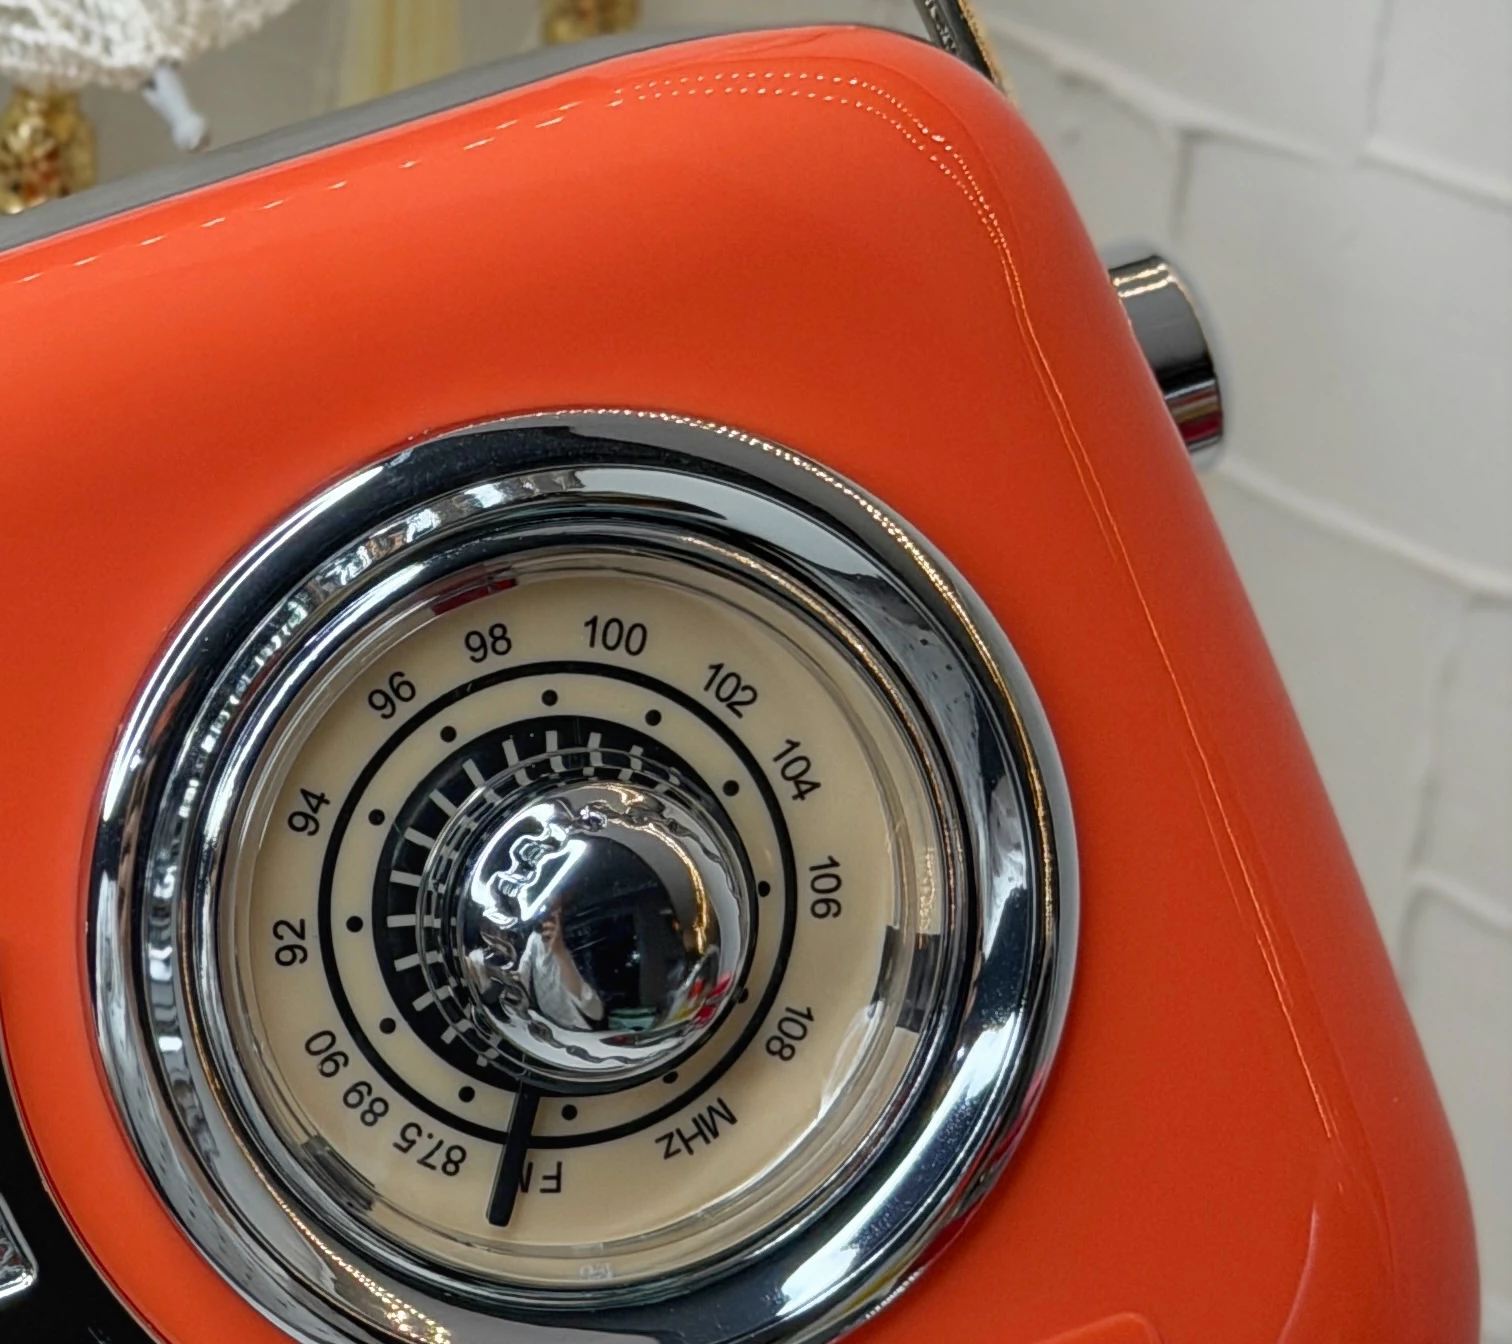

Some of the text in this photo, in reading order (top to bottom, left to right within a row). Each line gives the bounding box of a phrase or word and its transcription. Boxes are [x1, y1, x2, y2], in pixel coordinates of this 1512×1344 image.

[465, 623, 511, 663] 98
[584, 616, 647, 656] 100
[368, 672, 416, 719] 96
[704, 663, 757, 718] 102
[773, 740, 821, 800] 104
[288, 789, 330, 836] 94
[809, 856, 841, 918] 106
[273, 919, 307, 966] 92
[305, 1031, 349, 1077] 90
[765, 1007, 813, 1061] 108
[343, 1081, 389, 1126] 89
[394, 1123, 466, 1176] 87.5
[655, 1097, 737, 1159] MHz
